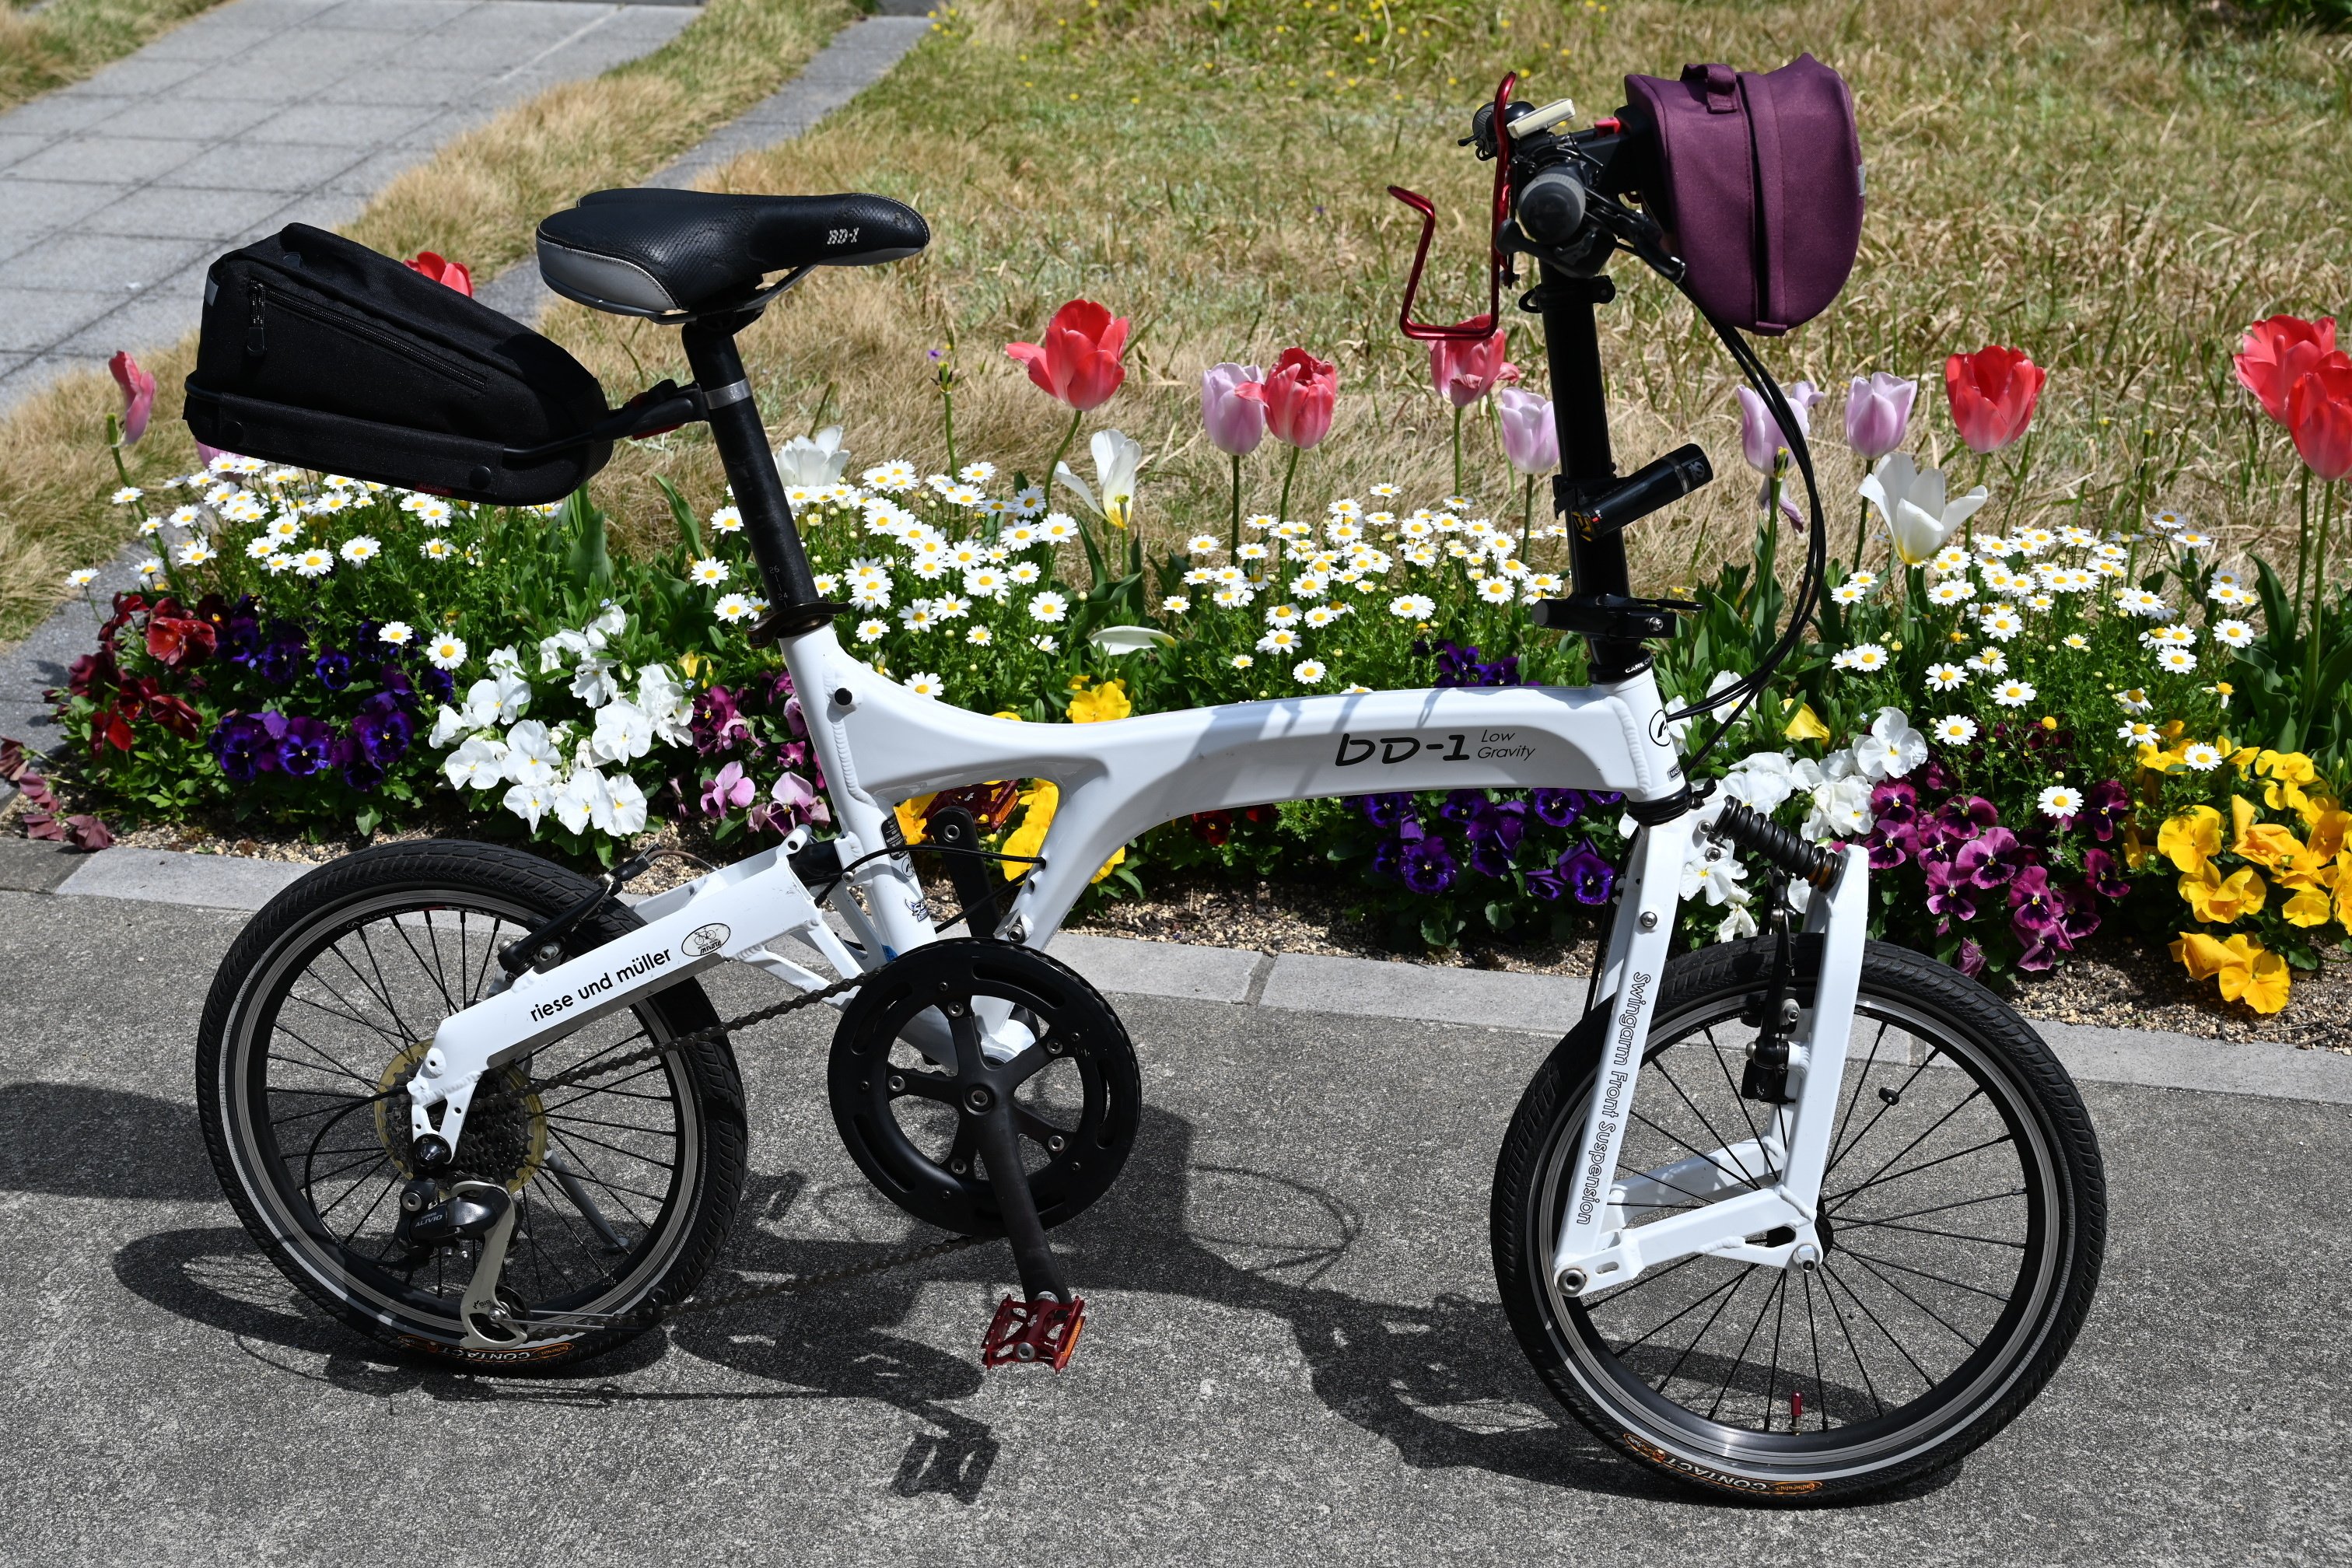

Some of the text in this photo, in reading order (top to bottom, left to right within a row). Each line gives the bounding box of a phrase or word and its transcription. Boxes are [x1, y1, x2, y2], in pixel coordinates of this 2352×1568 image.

[1626, 662, 1645, 674] CANE
[1481, 729, 1515, 743] Low
[1477, 745, 1536, 761] Gravity
[530, 948, 672, 1022] riese und müller
[1577, 971, 1651, 1226] Swingarm Front Suspension
[415, 1215, 443, 1228] ALIVIO
[442, 1347, 531, 1361] CONTACT
[1664, 1458, 1768, 1491] CONTACT
